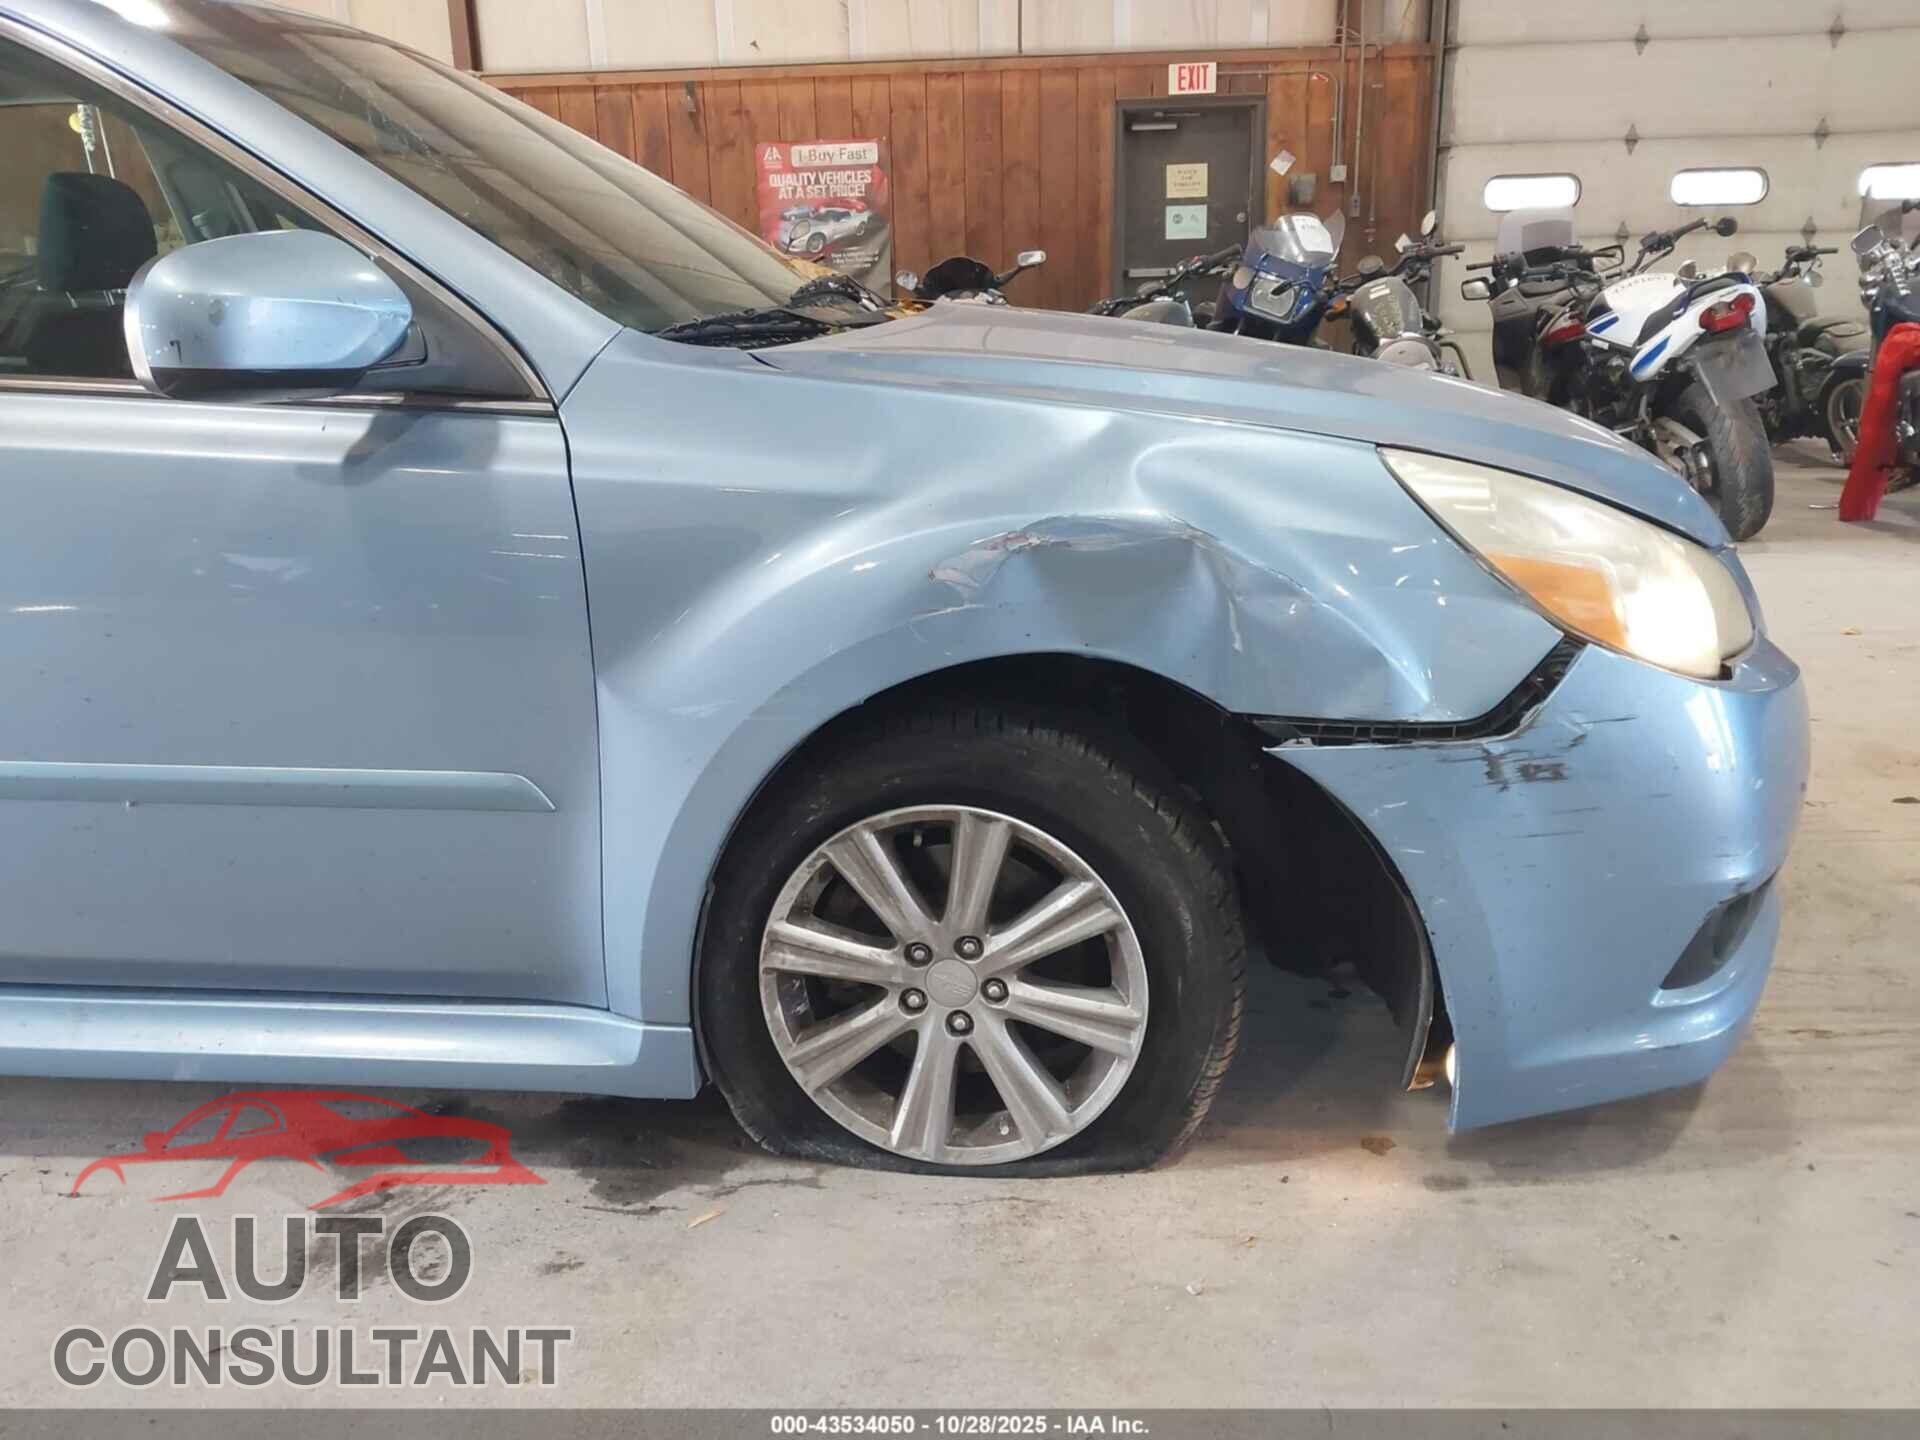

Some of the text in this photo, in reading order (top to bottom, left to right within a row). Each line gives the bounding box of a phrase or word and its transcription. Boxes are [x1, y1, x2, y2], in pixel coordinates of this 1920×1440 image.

[1178, 65, 1209, 91] EXIT
[839, 147, 868, 160] Fast
[769, 170, 872, 187] QUALITY VEHICLES
[778, 185, 795, 199] AT
[796, 185, 805, 199] A
[806, 184, 828, 198] SET
